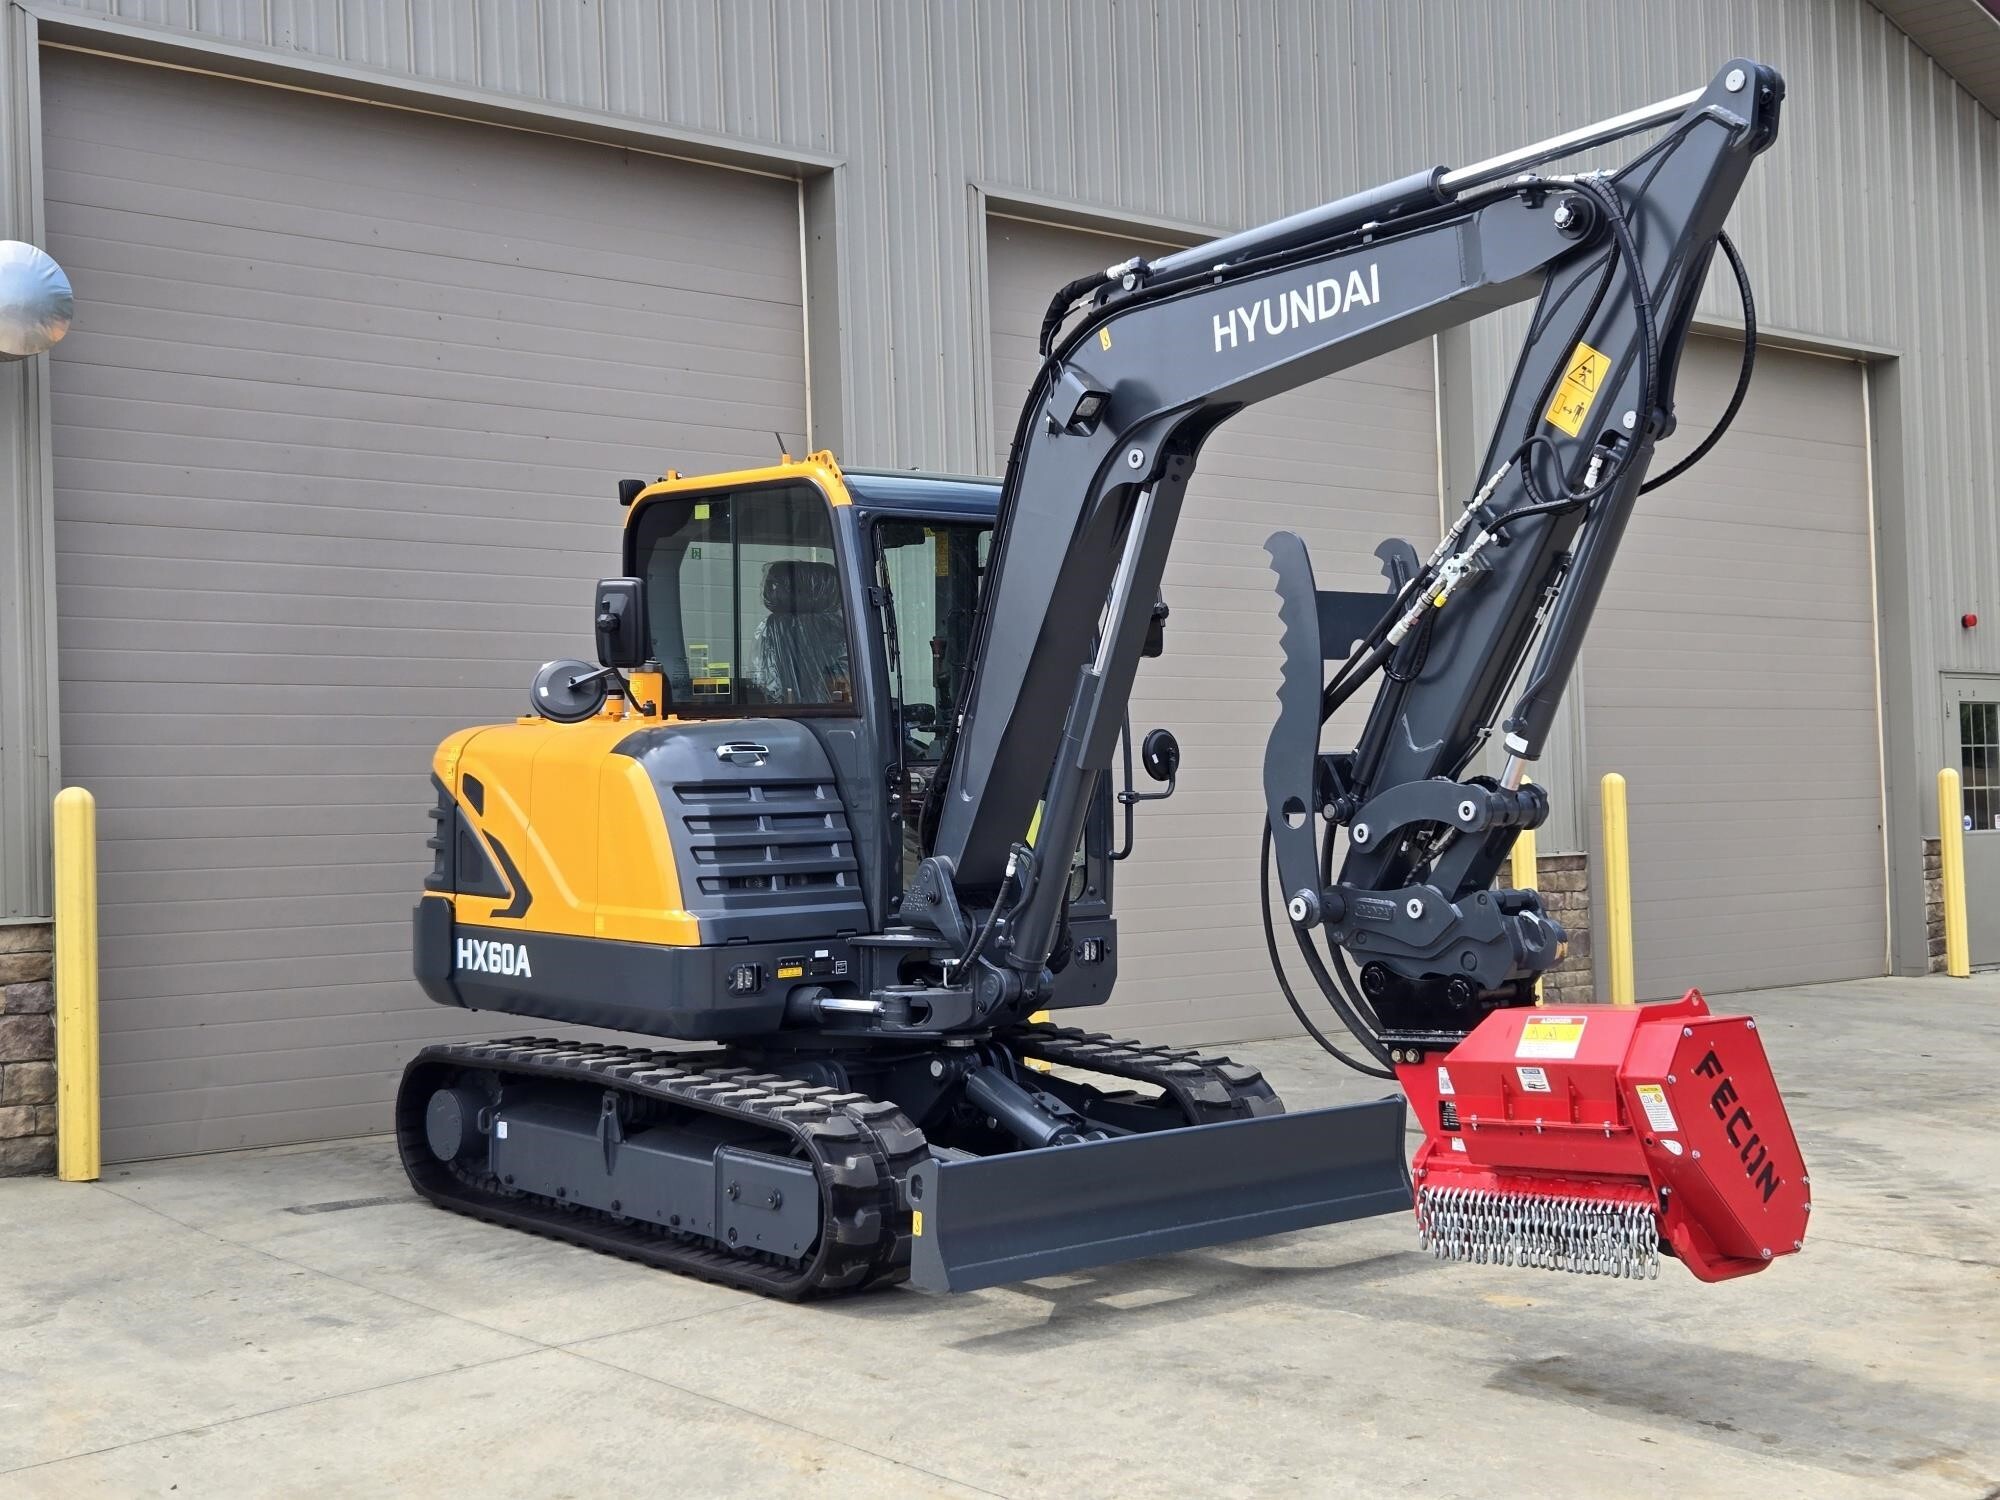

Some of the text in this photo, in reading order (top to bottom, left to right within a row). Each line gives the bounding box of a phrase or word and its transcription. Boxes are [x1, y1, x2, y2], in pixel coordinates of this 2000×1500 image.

[1213, 262, 1381, 353] HYUNDAI
[456, 937, 532, 978] HX60A
[1694, 1049, 1780, 1204] FECON
